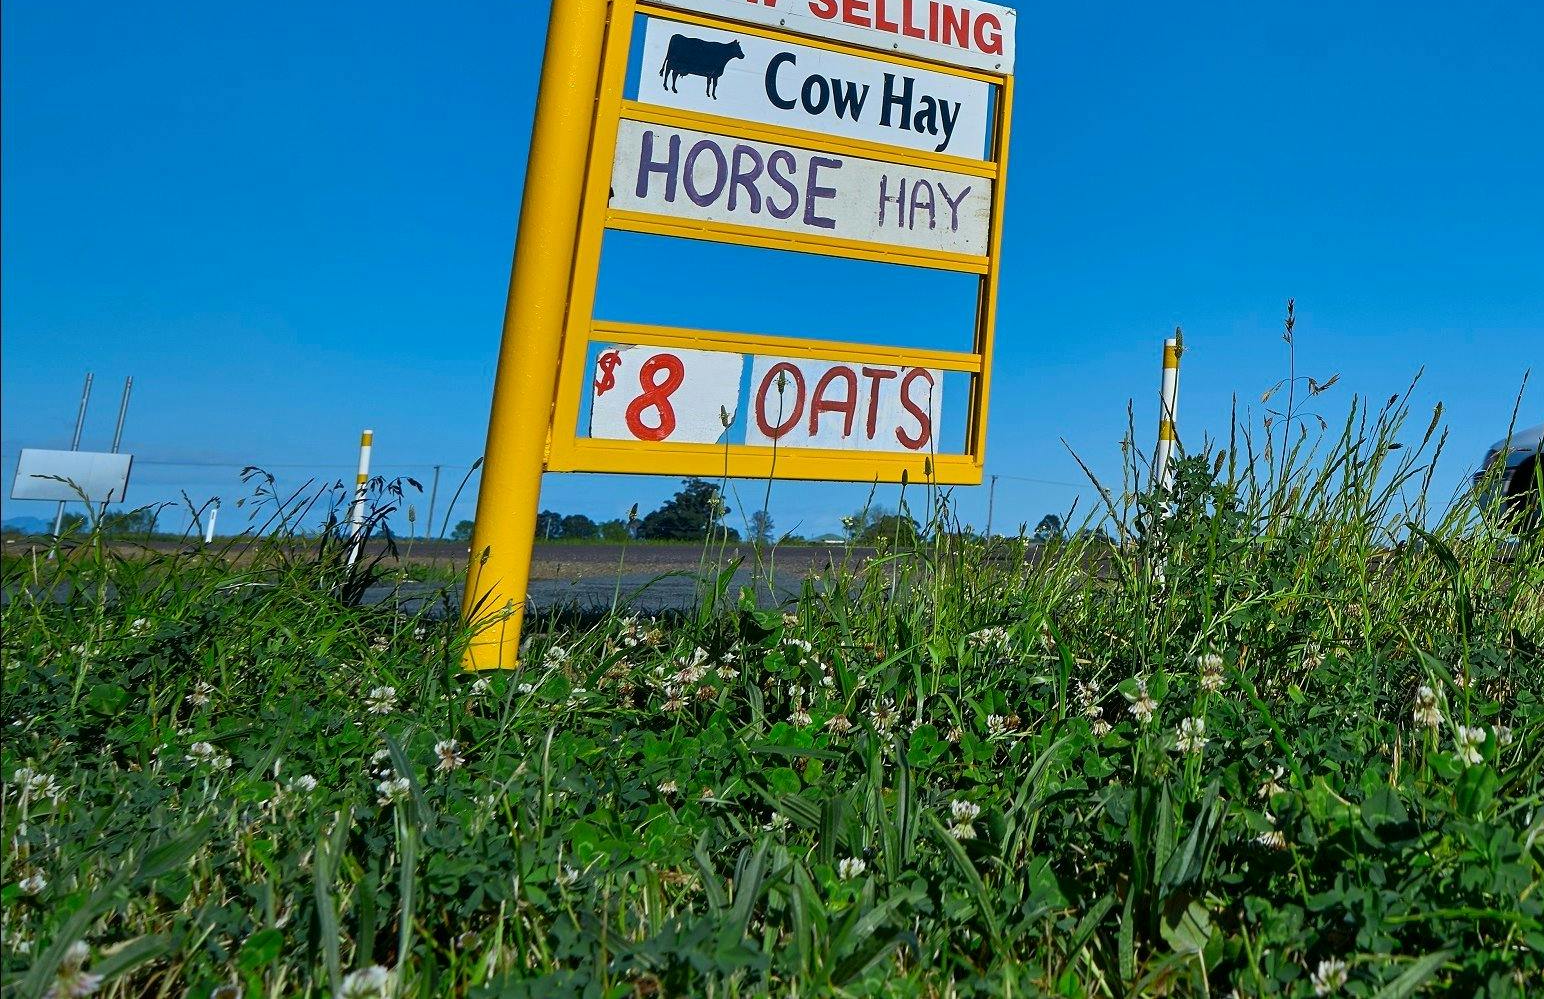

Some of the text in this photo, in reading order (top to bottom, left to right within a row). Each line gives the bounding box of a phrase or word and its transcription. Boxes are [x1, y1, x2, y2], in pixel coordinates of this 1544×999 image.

[764, 51, 962, 153] Cow Hay
[635, 130, 972, 231] HORSE HAY
